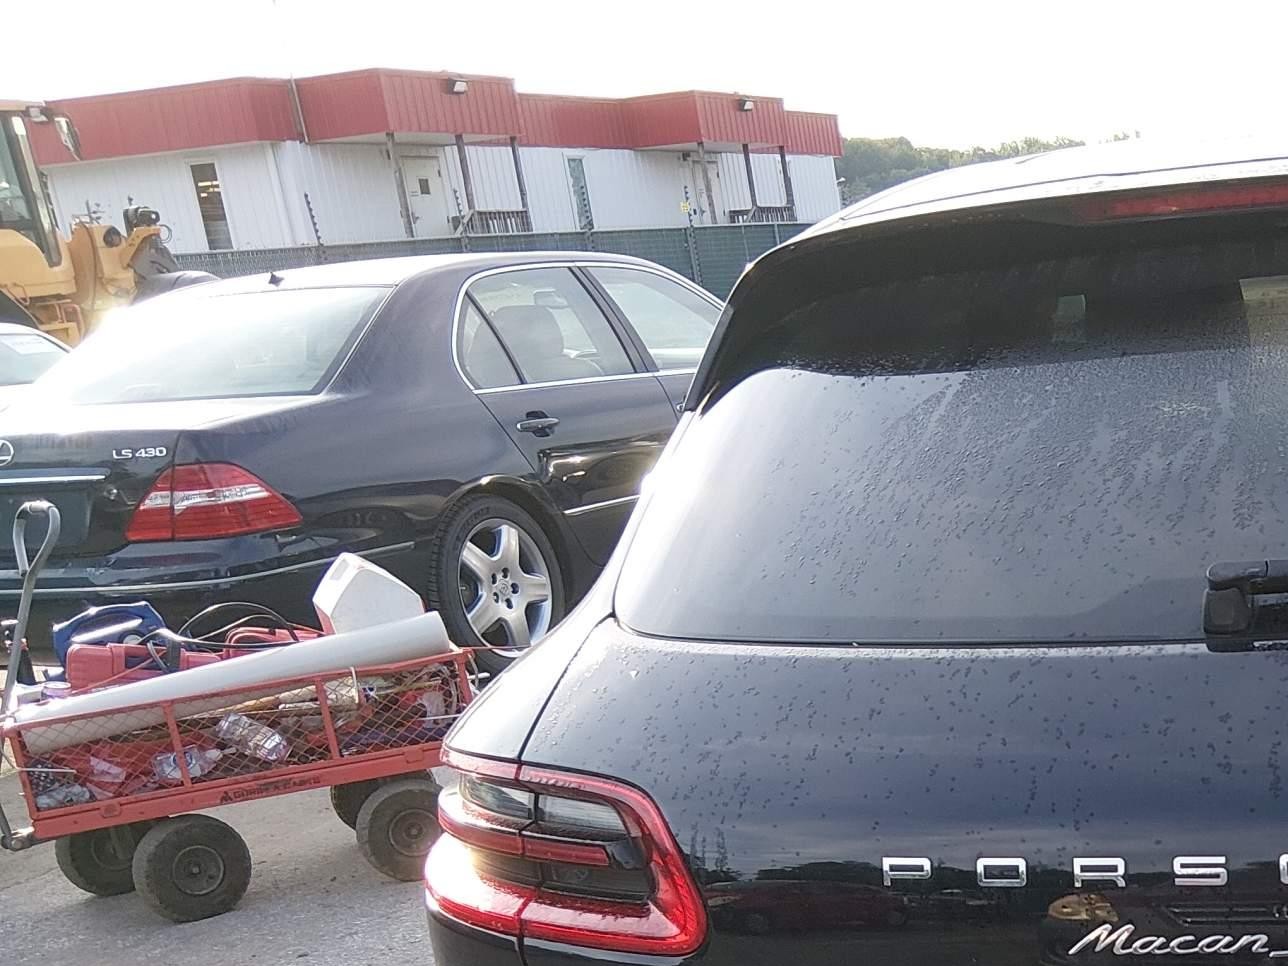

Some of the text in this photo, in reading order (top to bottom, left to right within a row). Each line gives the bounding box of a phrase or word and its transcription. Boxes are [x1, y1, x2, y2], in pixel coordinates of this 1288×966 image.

[112, 446, 167, 459] LS 430
[1068, 923, 1270, 955] Macan
